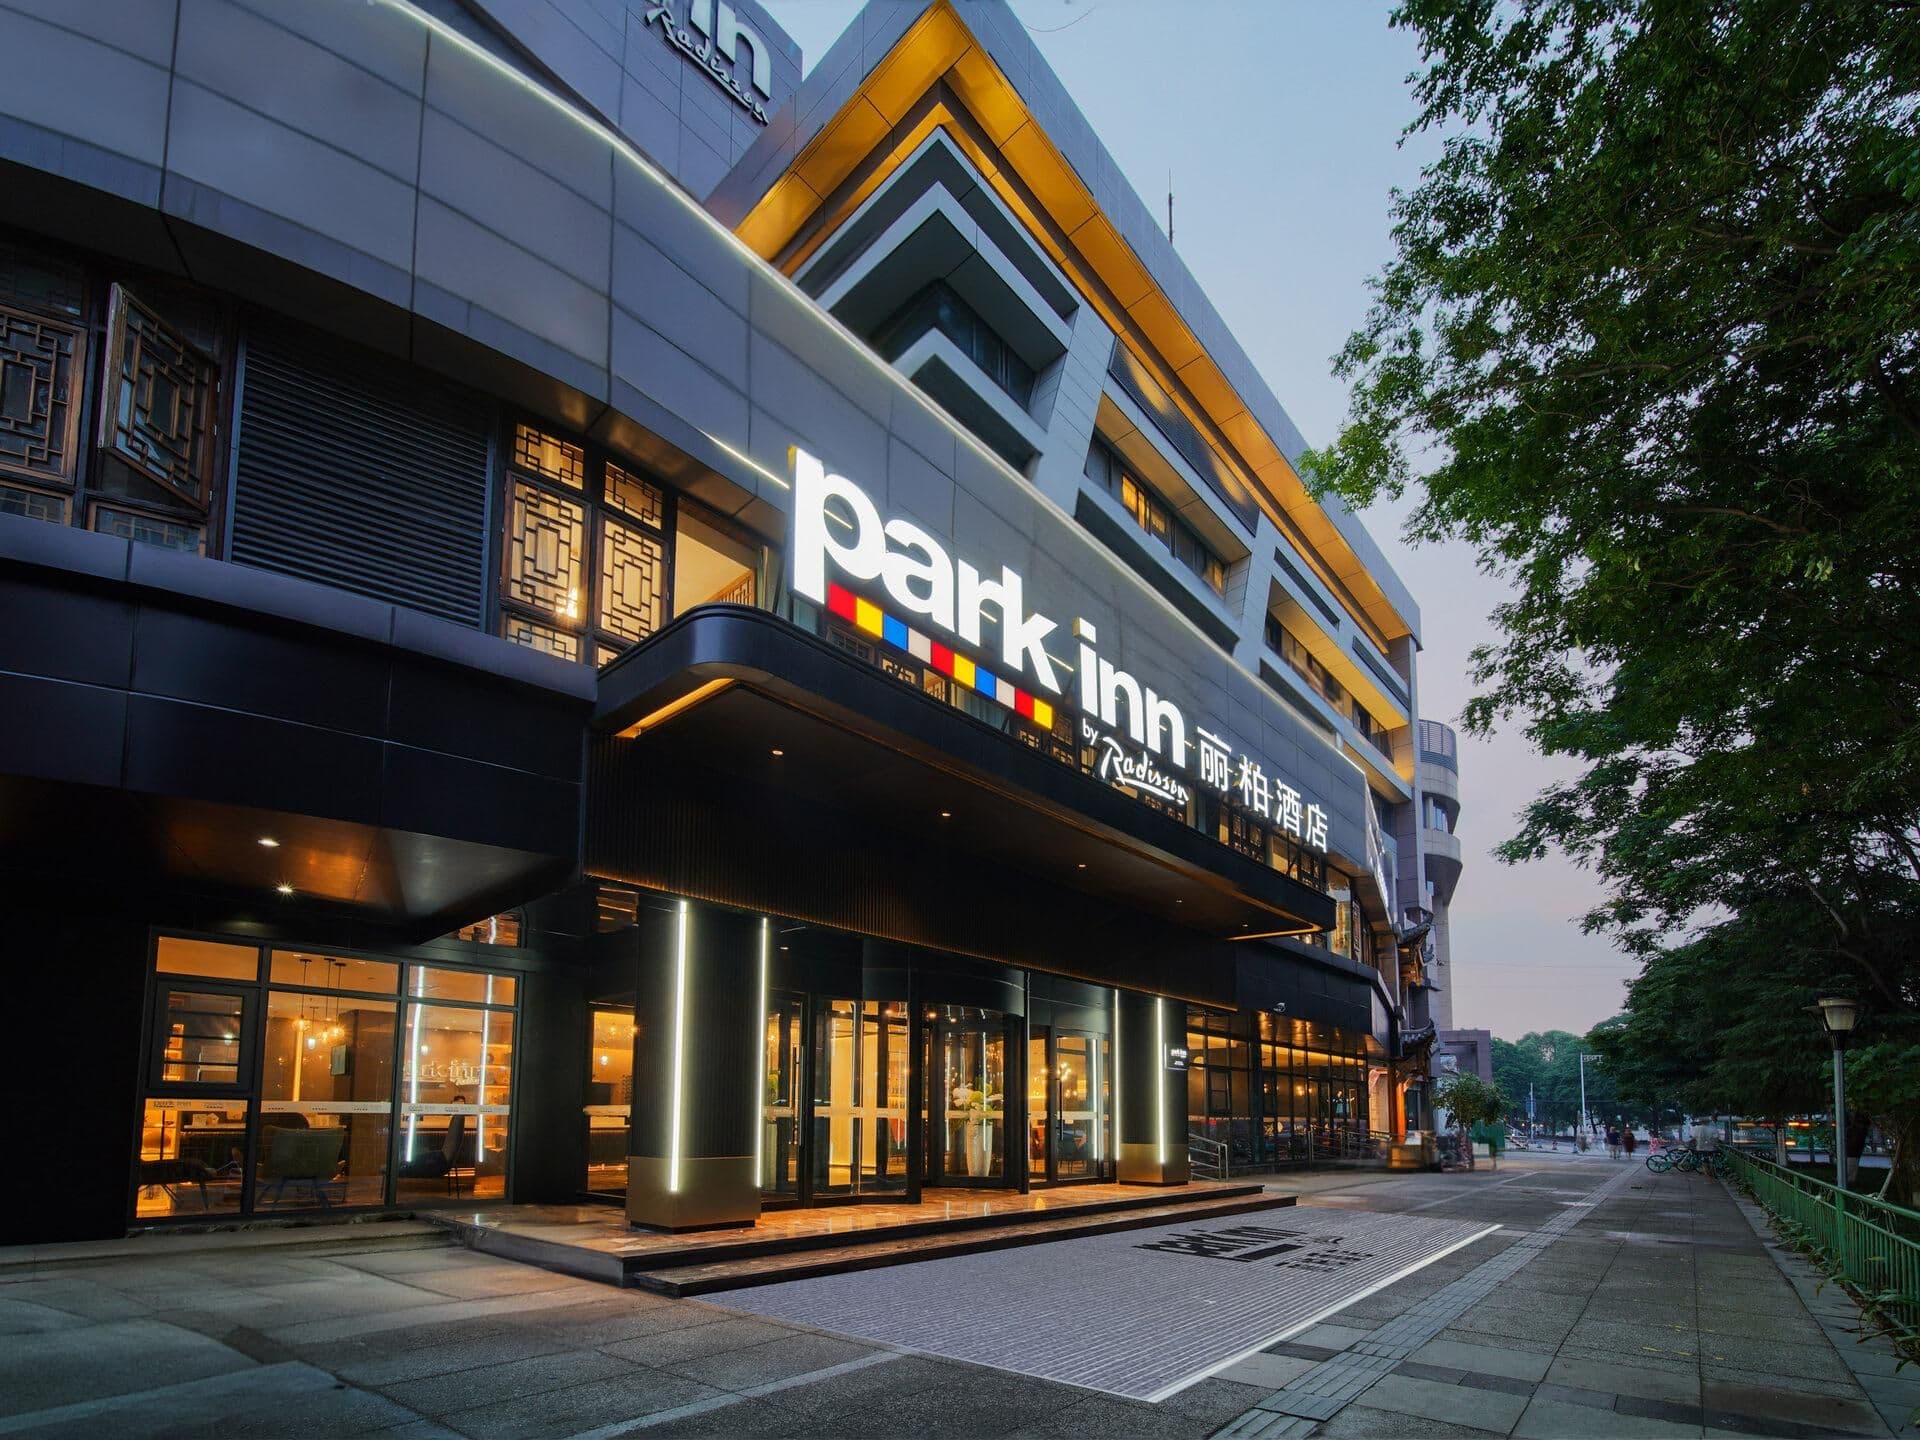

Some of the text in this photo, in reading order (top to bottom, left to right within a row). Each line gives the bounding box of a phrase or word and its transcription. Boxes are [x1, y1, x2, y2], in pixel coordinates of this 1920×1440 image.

[793, 447, 1186, 768] park inn
[1082, 717, 1098, 746] by
[1100, 736, 1189, 806] Radisson
[1196, 725, 1328, 853] 丽柏酒店
